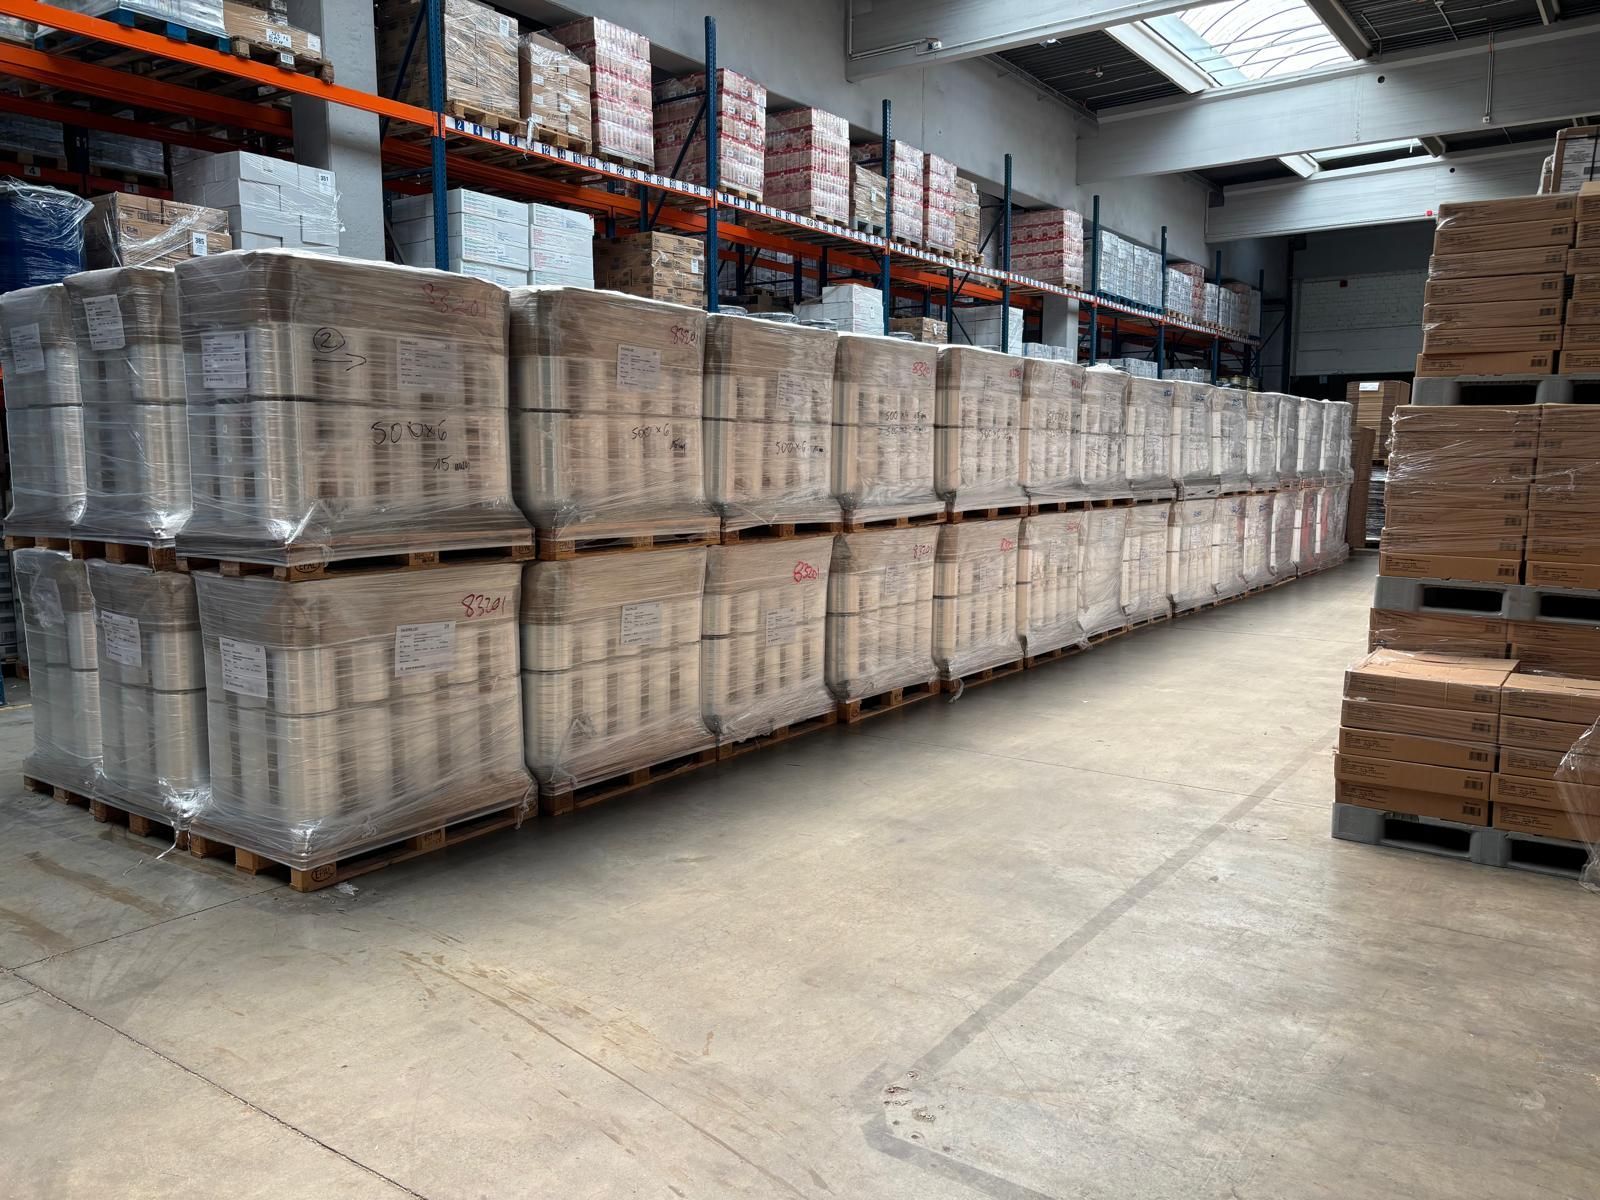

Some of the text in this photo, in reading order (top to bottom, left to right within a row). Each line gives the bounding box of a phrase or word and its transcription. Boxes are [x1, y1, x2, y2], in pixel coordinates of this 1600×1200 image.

[457, 121, 463, 130] 2
[475, 126, 481, 135] 4
[493, 131, 499, 141] 6
[511, 137, 516, 146] 8
[543, 145, 550, 155] 12
[559, 150, 566, 160] 14
[573, 154, 581, 164] 16
[588, 158, 596, 168] 18
[603, 162, 610, 172] 20
[617, 167, 624, 176] 22
[631, 170, 638, 179] 24
[644, 174, 651, 182] 26
[657, 177, 664, 186] 28
[682, 183, 689, 192] 32
[694, 185, 701, 194] 34
[433, 455, 453, 471] 15
[461, 593, 506, 617] 83201
